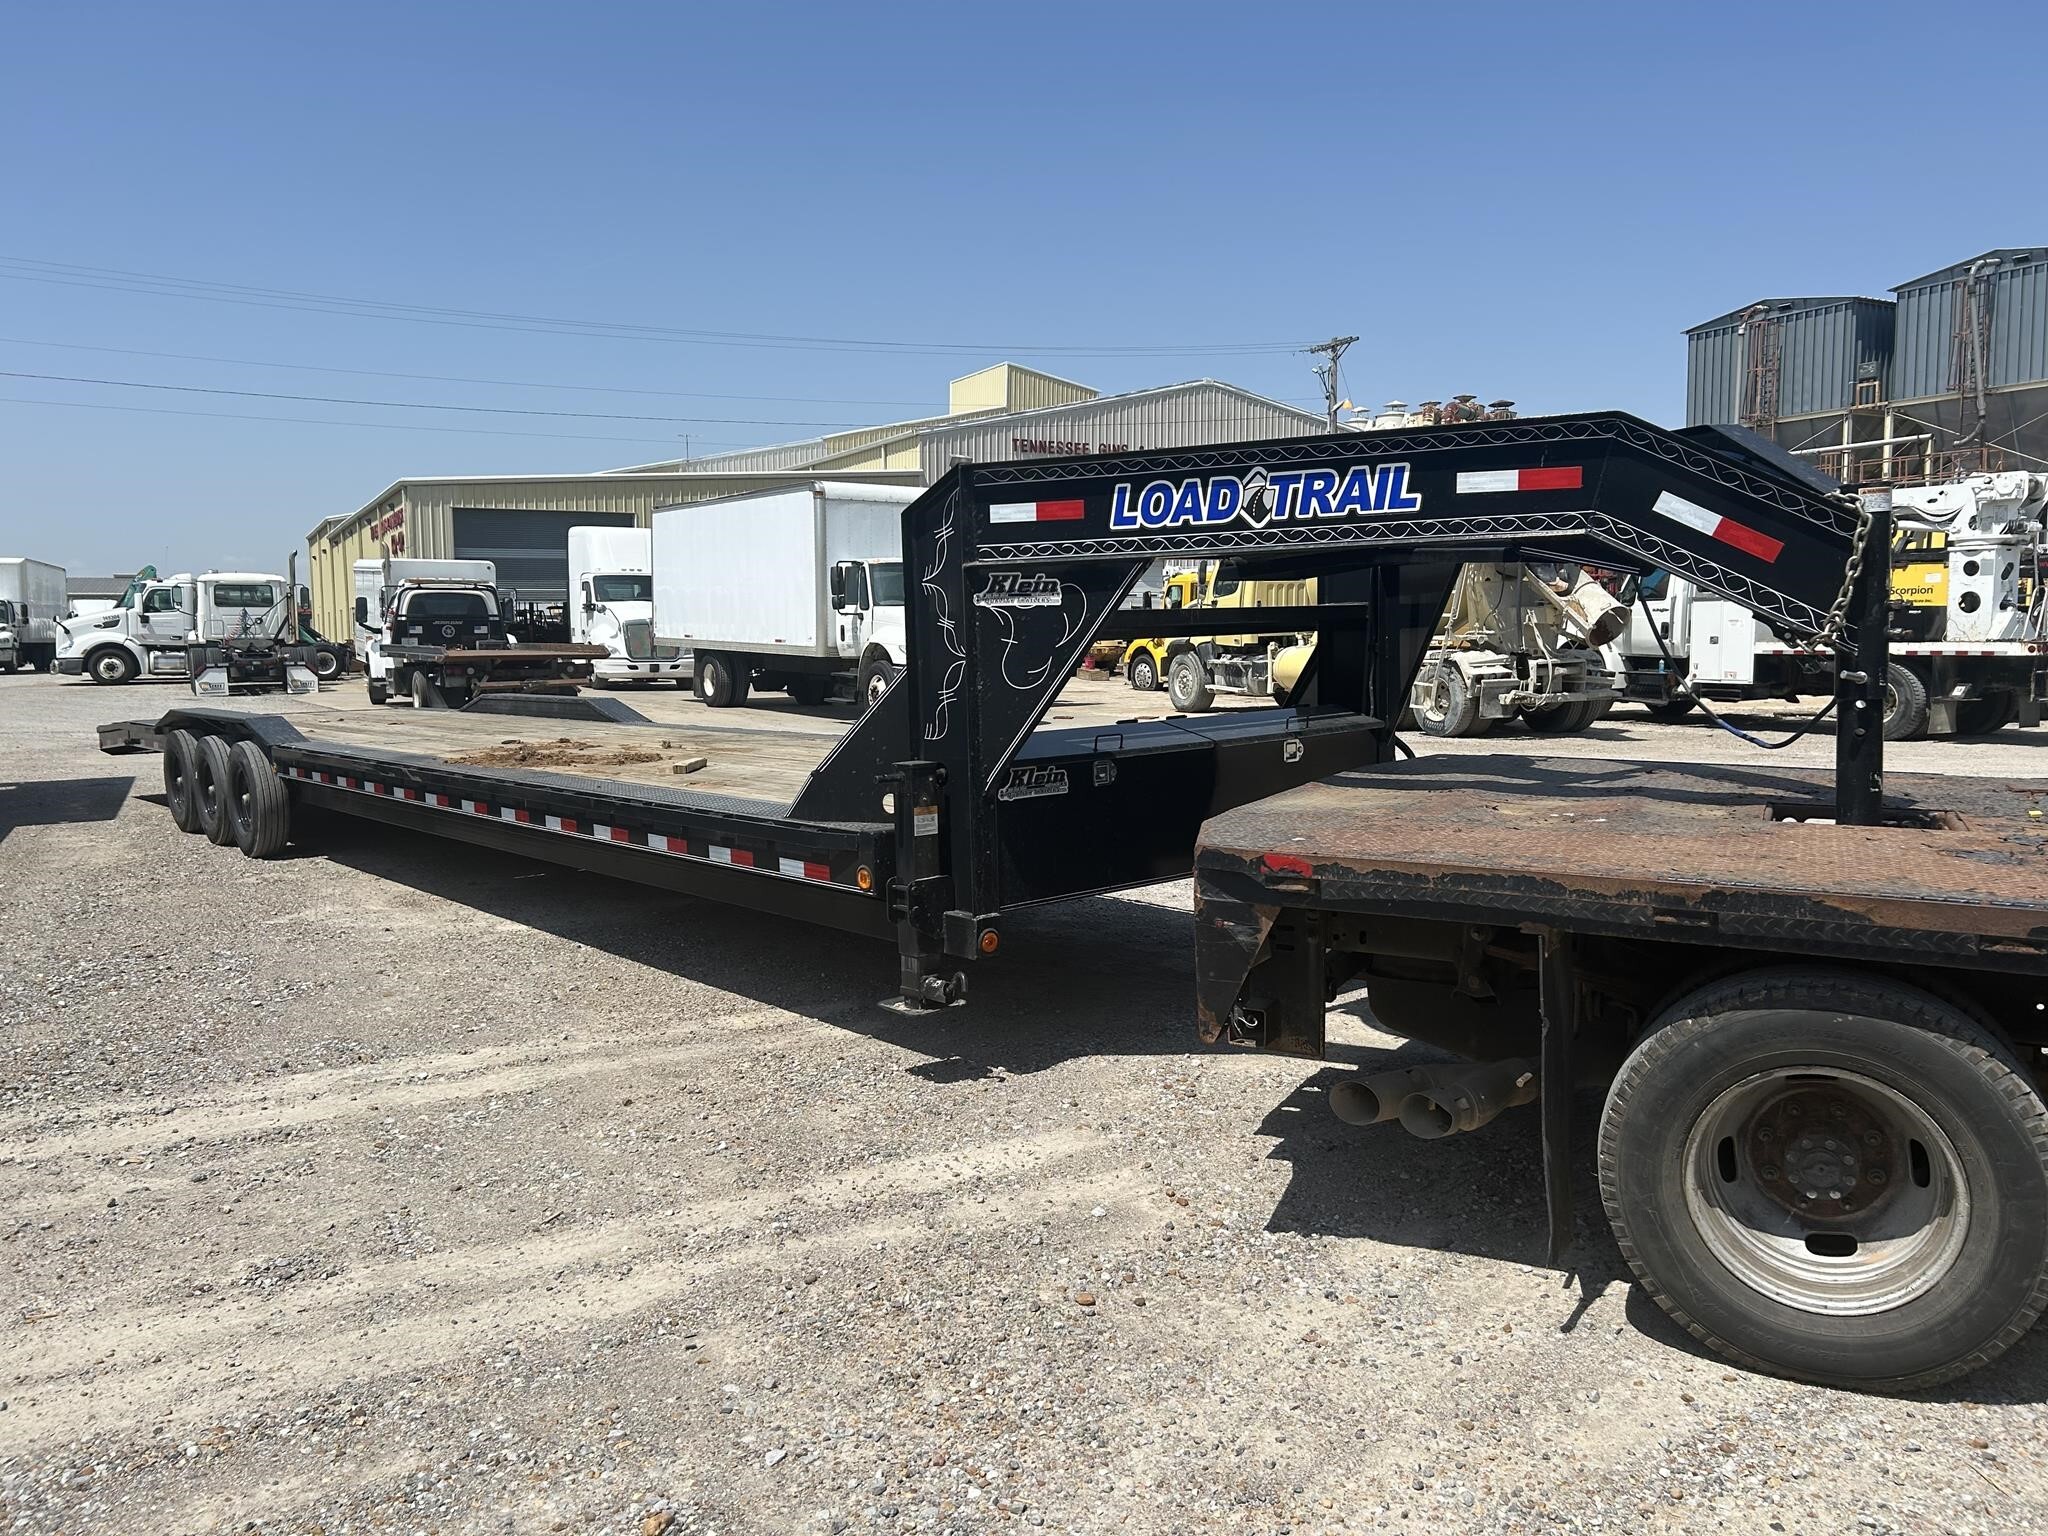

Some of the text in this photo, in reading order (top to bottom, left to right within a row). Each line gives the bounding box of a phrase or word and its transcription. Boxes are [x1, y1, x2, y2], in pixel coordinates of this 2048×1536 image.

[1012, 438, 1089, 455] TENNESSEE
[1110, 462, 1422, 529] LOAD TRAIL
[987, 572, 1060, 594] Klein
[1890, 585, 1933, 596] Scorpion
[1009, 766, 1067, 787] Klein
